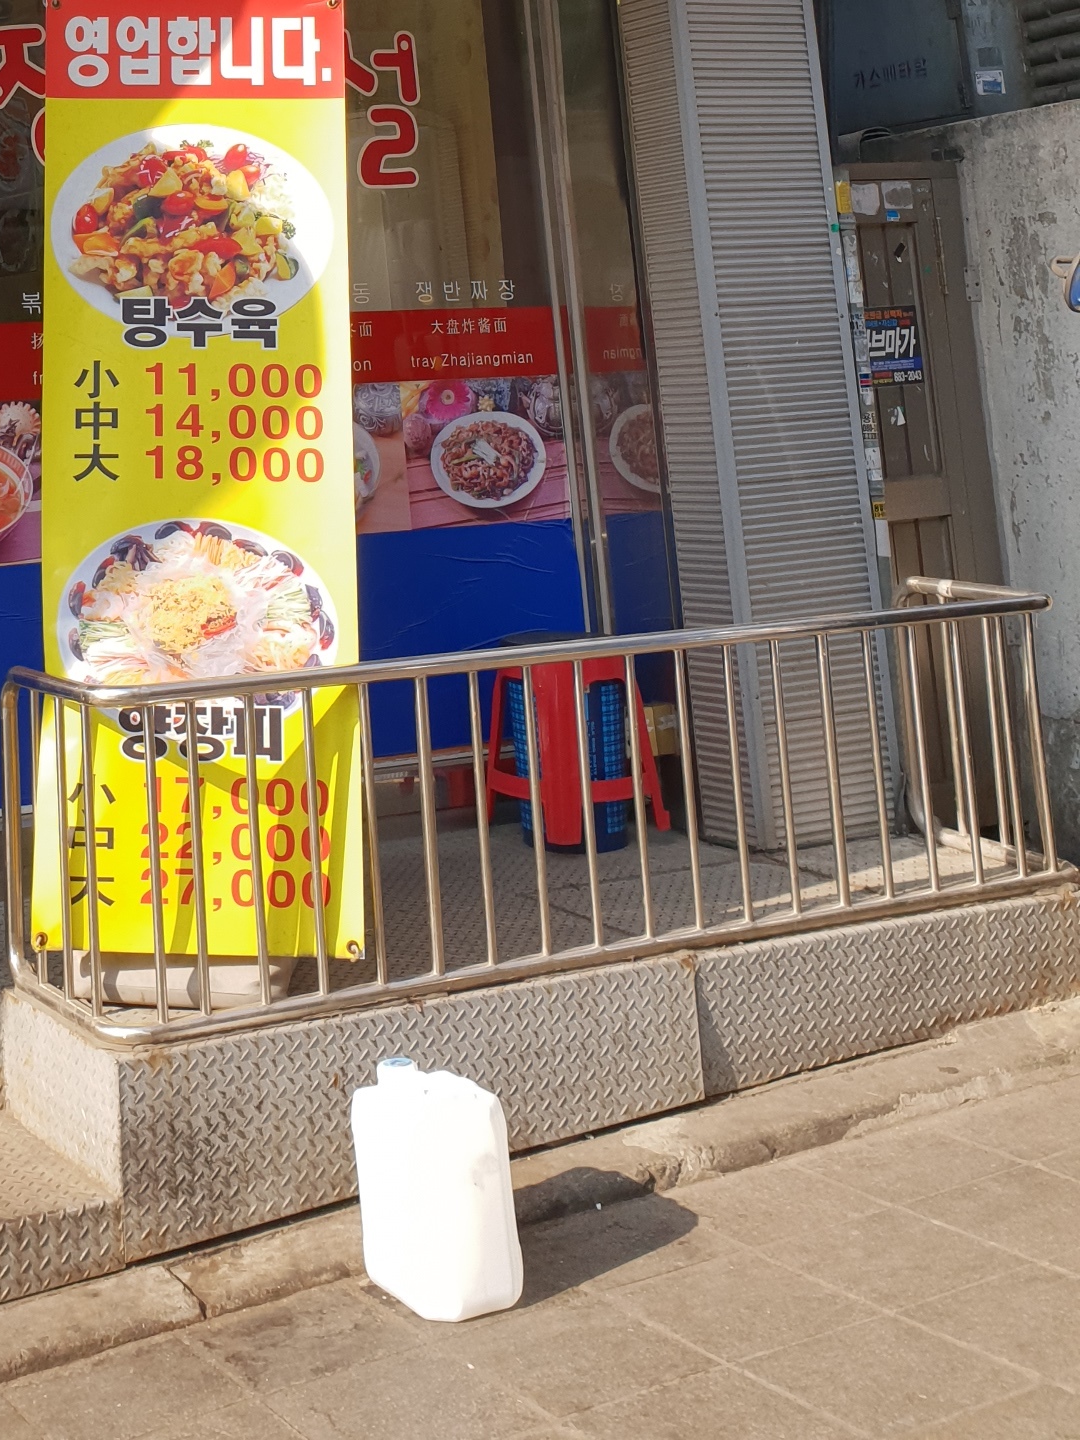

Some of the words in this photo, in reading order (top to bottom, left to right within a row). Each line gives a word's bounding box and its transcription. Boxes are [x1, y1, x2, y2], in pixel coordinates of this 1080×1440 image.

[64, 15, 333, 88] 영업합니다.
[414, 279, 516, 303] 쟁반짜장
[120, 296, 280, 349] 탕수육
[430, 316, 508, 337] 大盘炸酱面
[867, 326, 917, 358] 브마가
[74, 360, 119, 400] 小
[145, 363, 324, 402] 11,000
[411, 353, 437, 370] tray
[440, 350, 534, 369] Zhajiangmian
[74, 400, 119, 441] 中
[145, 404, 325, 443] 14,000
[73, 444, 120, 482] 大
[145, 446, 325, 486] 18,000
[117, 705, 284, 763] 양장피
[142, 777, 330, 819] 17,000
[140, 822, 332, 865] 22,000
[140, 868, 332, 912] 27,000
